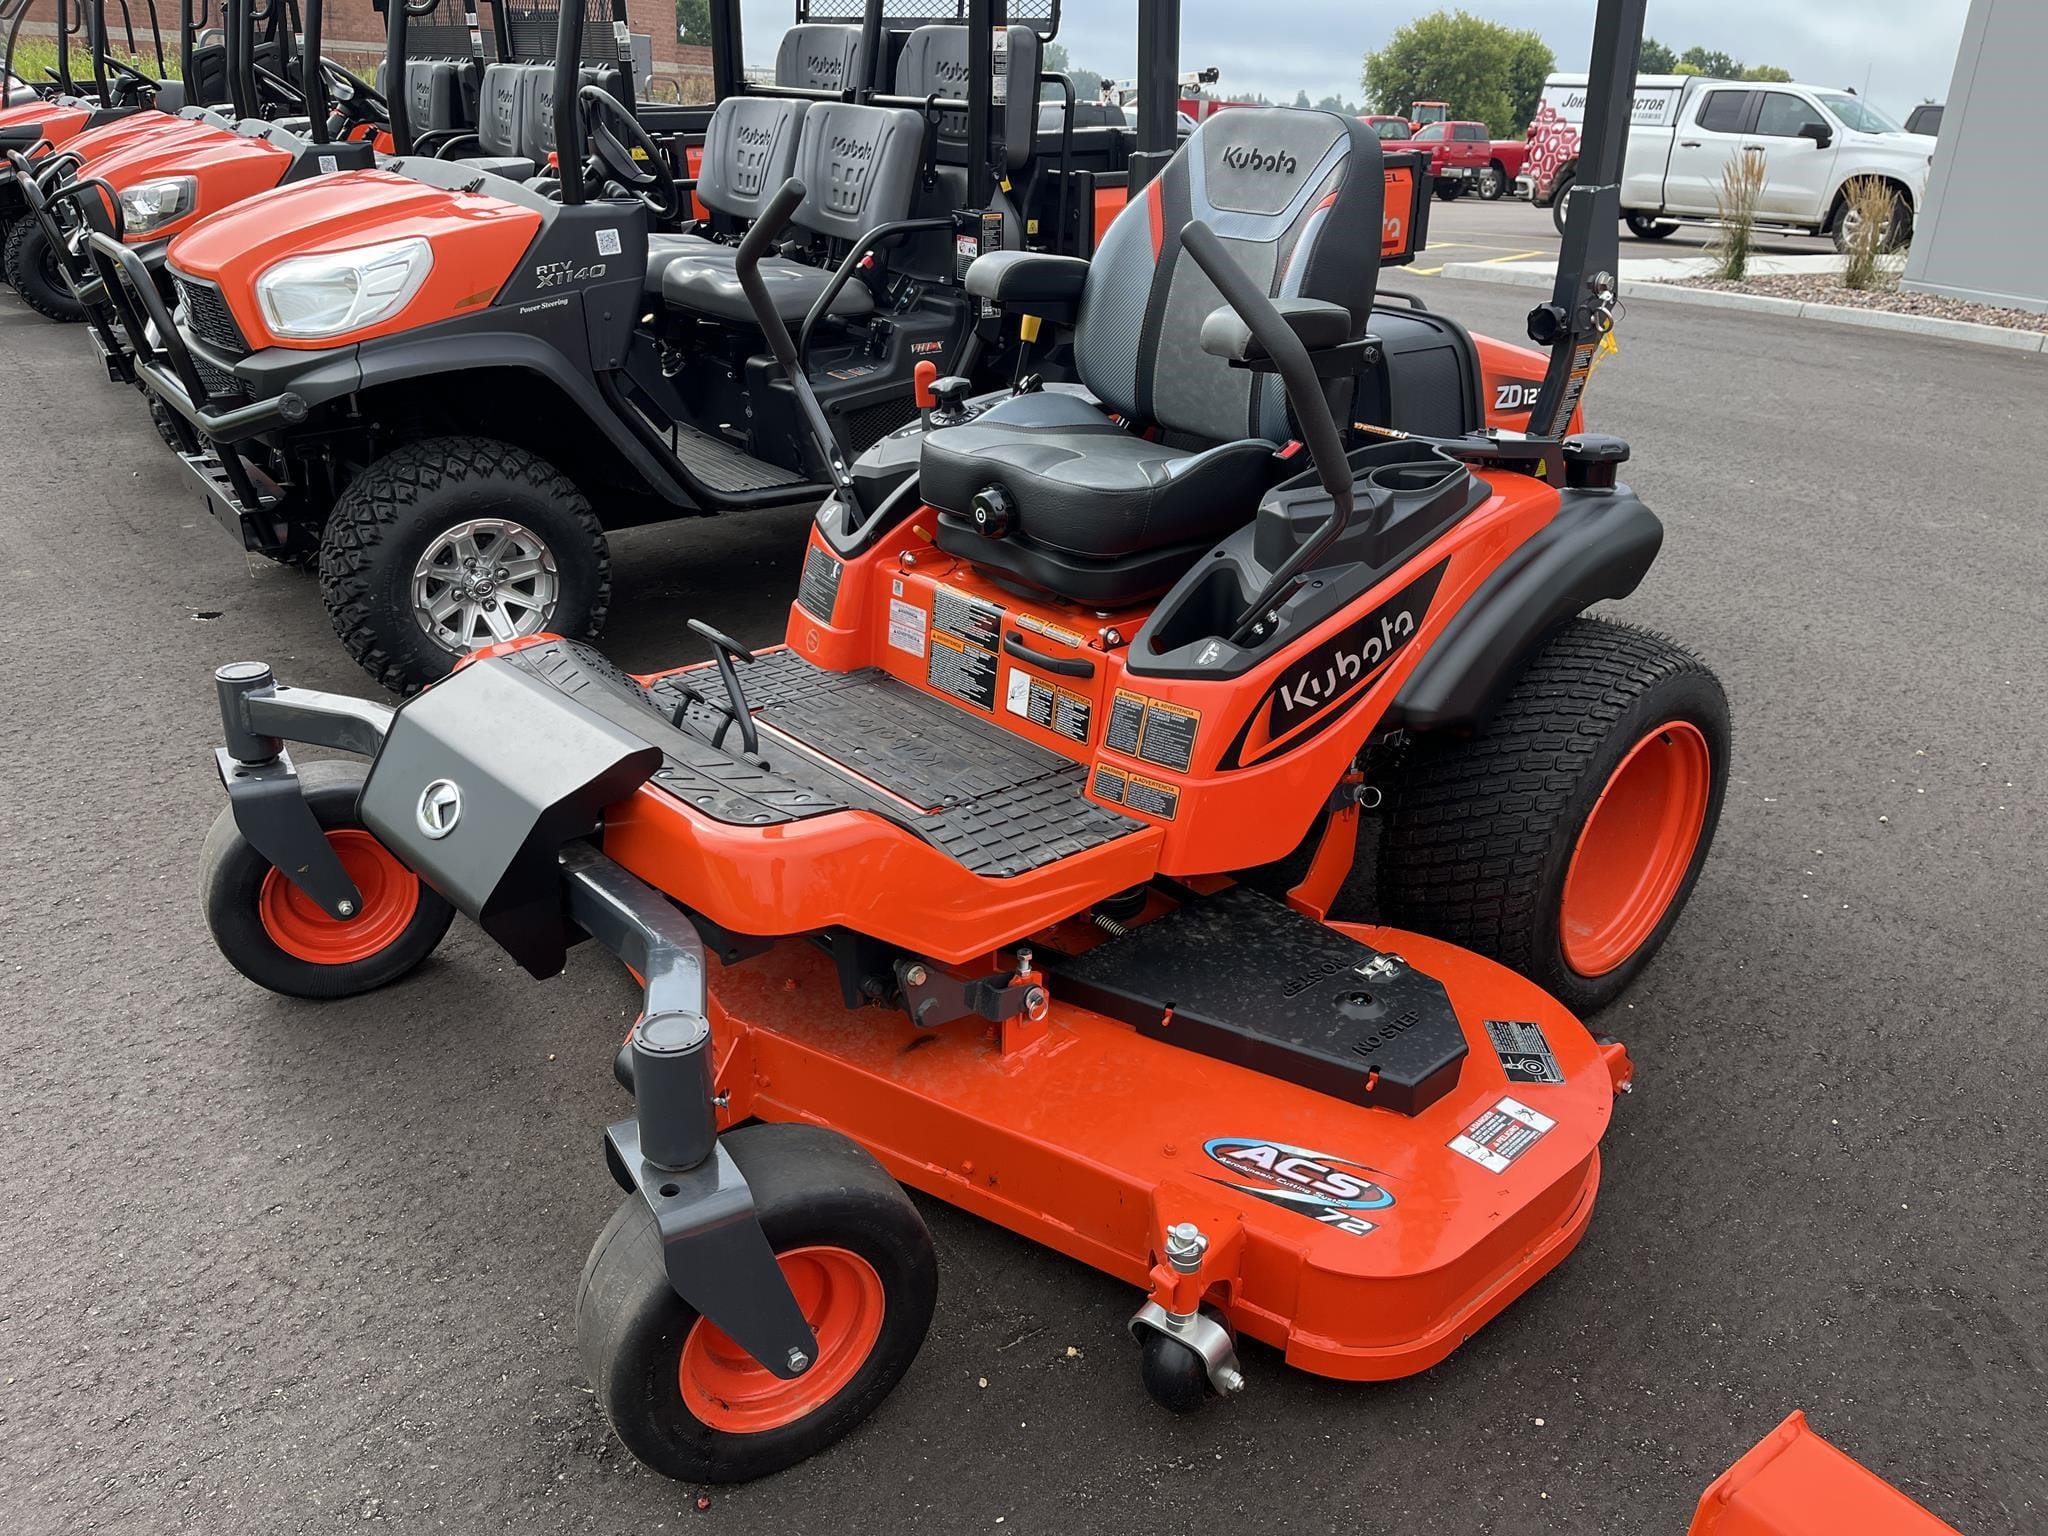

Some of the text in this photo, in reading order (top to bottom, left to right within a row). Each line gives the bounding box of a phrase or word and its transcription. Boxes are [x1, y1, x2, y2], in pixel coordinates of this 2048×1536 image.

[935, 61, 969, 81] Kubo
[1222, 146, 1297, 175] Kubota
[536, 260, 573, 275] RTV
[536, 264, 606, 289] X1140
[519, 298, 569, 314] Power Steering
[1494, 384, 1541, 409] ZD12
[1280, 610, 1414, 711] Kubota
[1159, 703, 1194, 716] ADVERTENCIA
[1138, 776, 1175, 793] ADVERTENCIA
[1217, 1157, 1349, 1208] Aerodynamic Cutting System
[1228, 1144, 1373, 1199] ACS
[1316, 1207, 1373, 1236] 72
